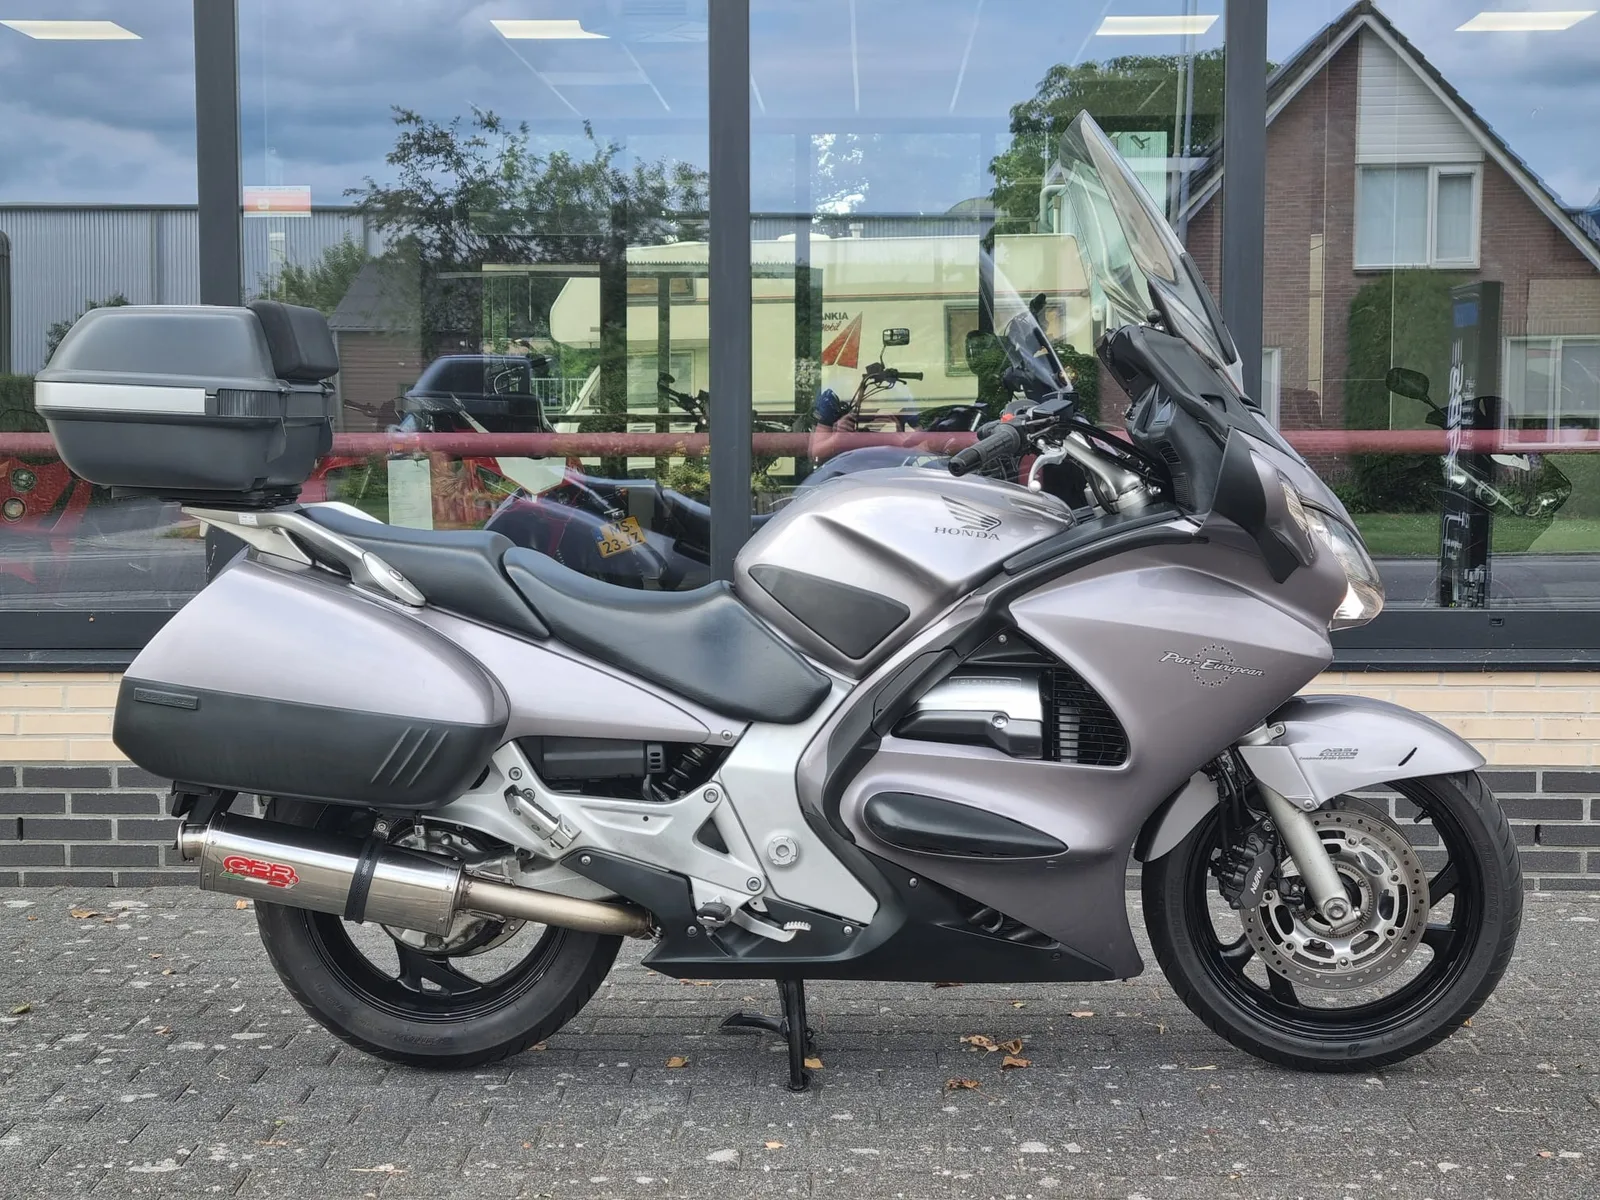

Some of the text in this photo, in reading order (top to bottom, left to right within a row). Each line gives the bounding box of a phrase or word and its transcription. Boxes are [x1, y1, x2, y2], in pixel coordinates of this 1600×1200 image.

[821, 312, 849, 320] NKIA
[934, 526, 1001, 541] HONDA
[1159, 650, 1265, 676] Pan-European
